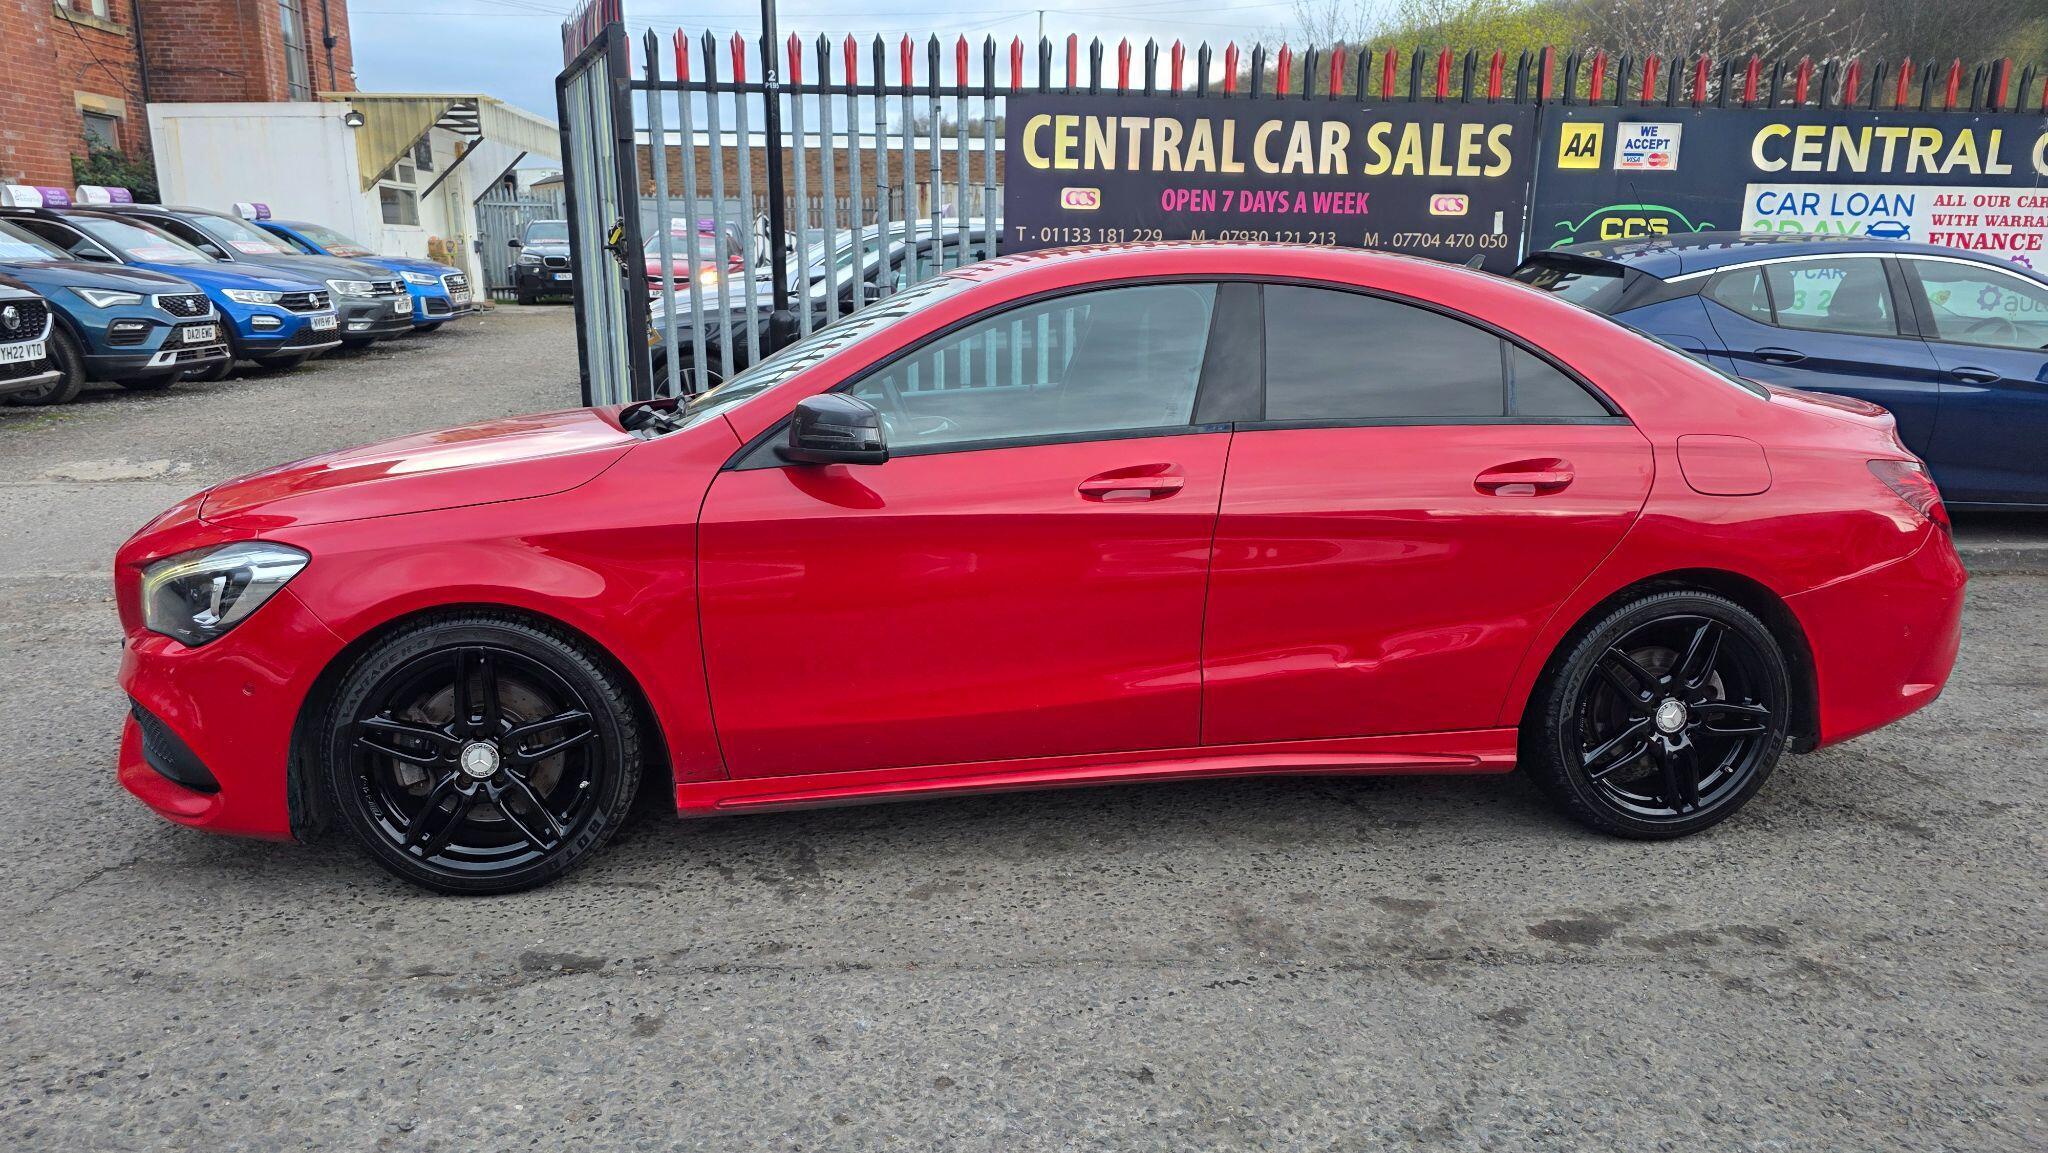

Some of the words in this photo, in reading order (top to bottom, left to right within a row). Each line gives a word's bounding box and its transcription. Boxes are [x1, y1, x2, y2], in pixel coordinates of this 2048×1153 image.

[767, 69, 776, 82] 2
[1640, 125, 1659, 137] WE
[1022, 114, 1245, 173] CENTRAL
[1253, 119, 1352, 175] CAR
[1364, 122, 1513, 177] SALES
[1564, 132, 1597, 157] AA
[1625, 138, 1671, 150] ACCEPT
[1751, 123, 2013, 175] CENTRAL
[1161, 188, 1217, 212] OPEN
[1222, 190, 1235, 212] 7
[1239, 190, 1290, 213] DAYS
[1293, 191, 1308, 214] A
[1312, 191, 1371, 215] WEEK
[1755, 191, 1821, 216] CAR
[1830, 192, 1916, 217] LOAN
[1933, 194, 1967, 207] ALL
[1973, 195, 2011, 208] OUR
[1601, 217, 1669, 240] CCS
[1931, 214, 1979, 227] WITH
[1984, 215, 2048, 228] WARRA
[1040, 227, 1092, 243] 01133
[1099, 228, 1125, 244] 181
[1132, 229, 1163, 243] 229
[1219, 230, 1269, 242] 07930
[1275, 231, 1301, 244] 121
[1308, 231, 1336, 246] 213
[1392, 232, 1441, 248] 07704
[1445, 233, 1475, 248] 470
[1479, 233, 1508, 249] 050
[1928, 232, 2044, 251] FINANCE
[1, 345, 24, 360] YH22
[26, 343, 43, 358] VTO
